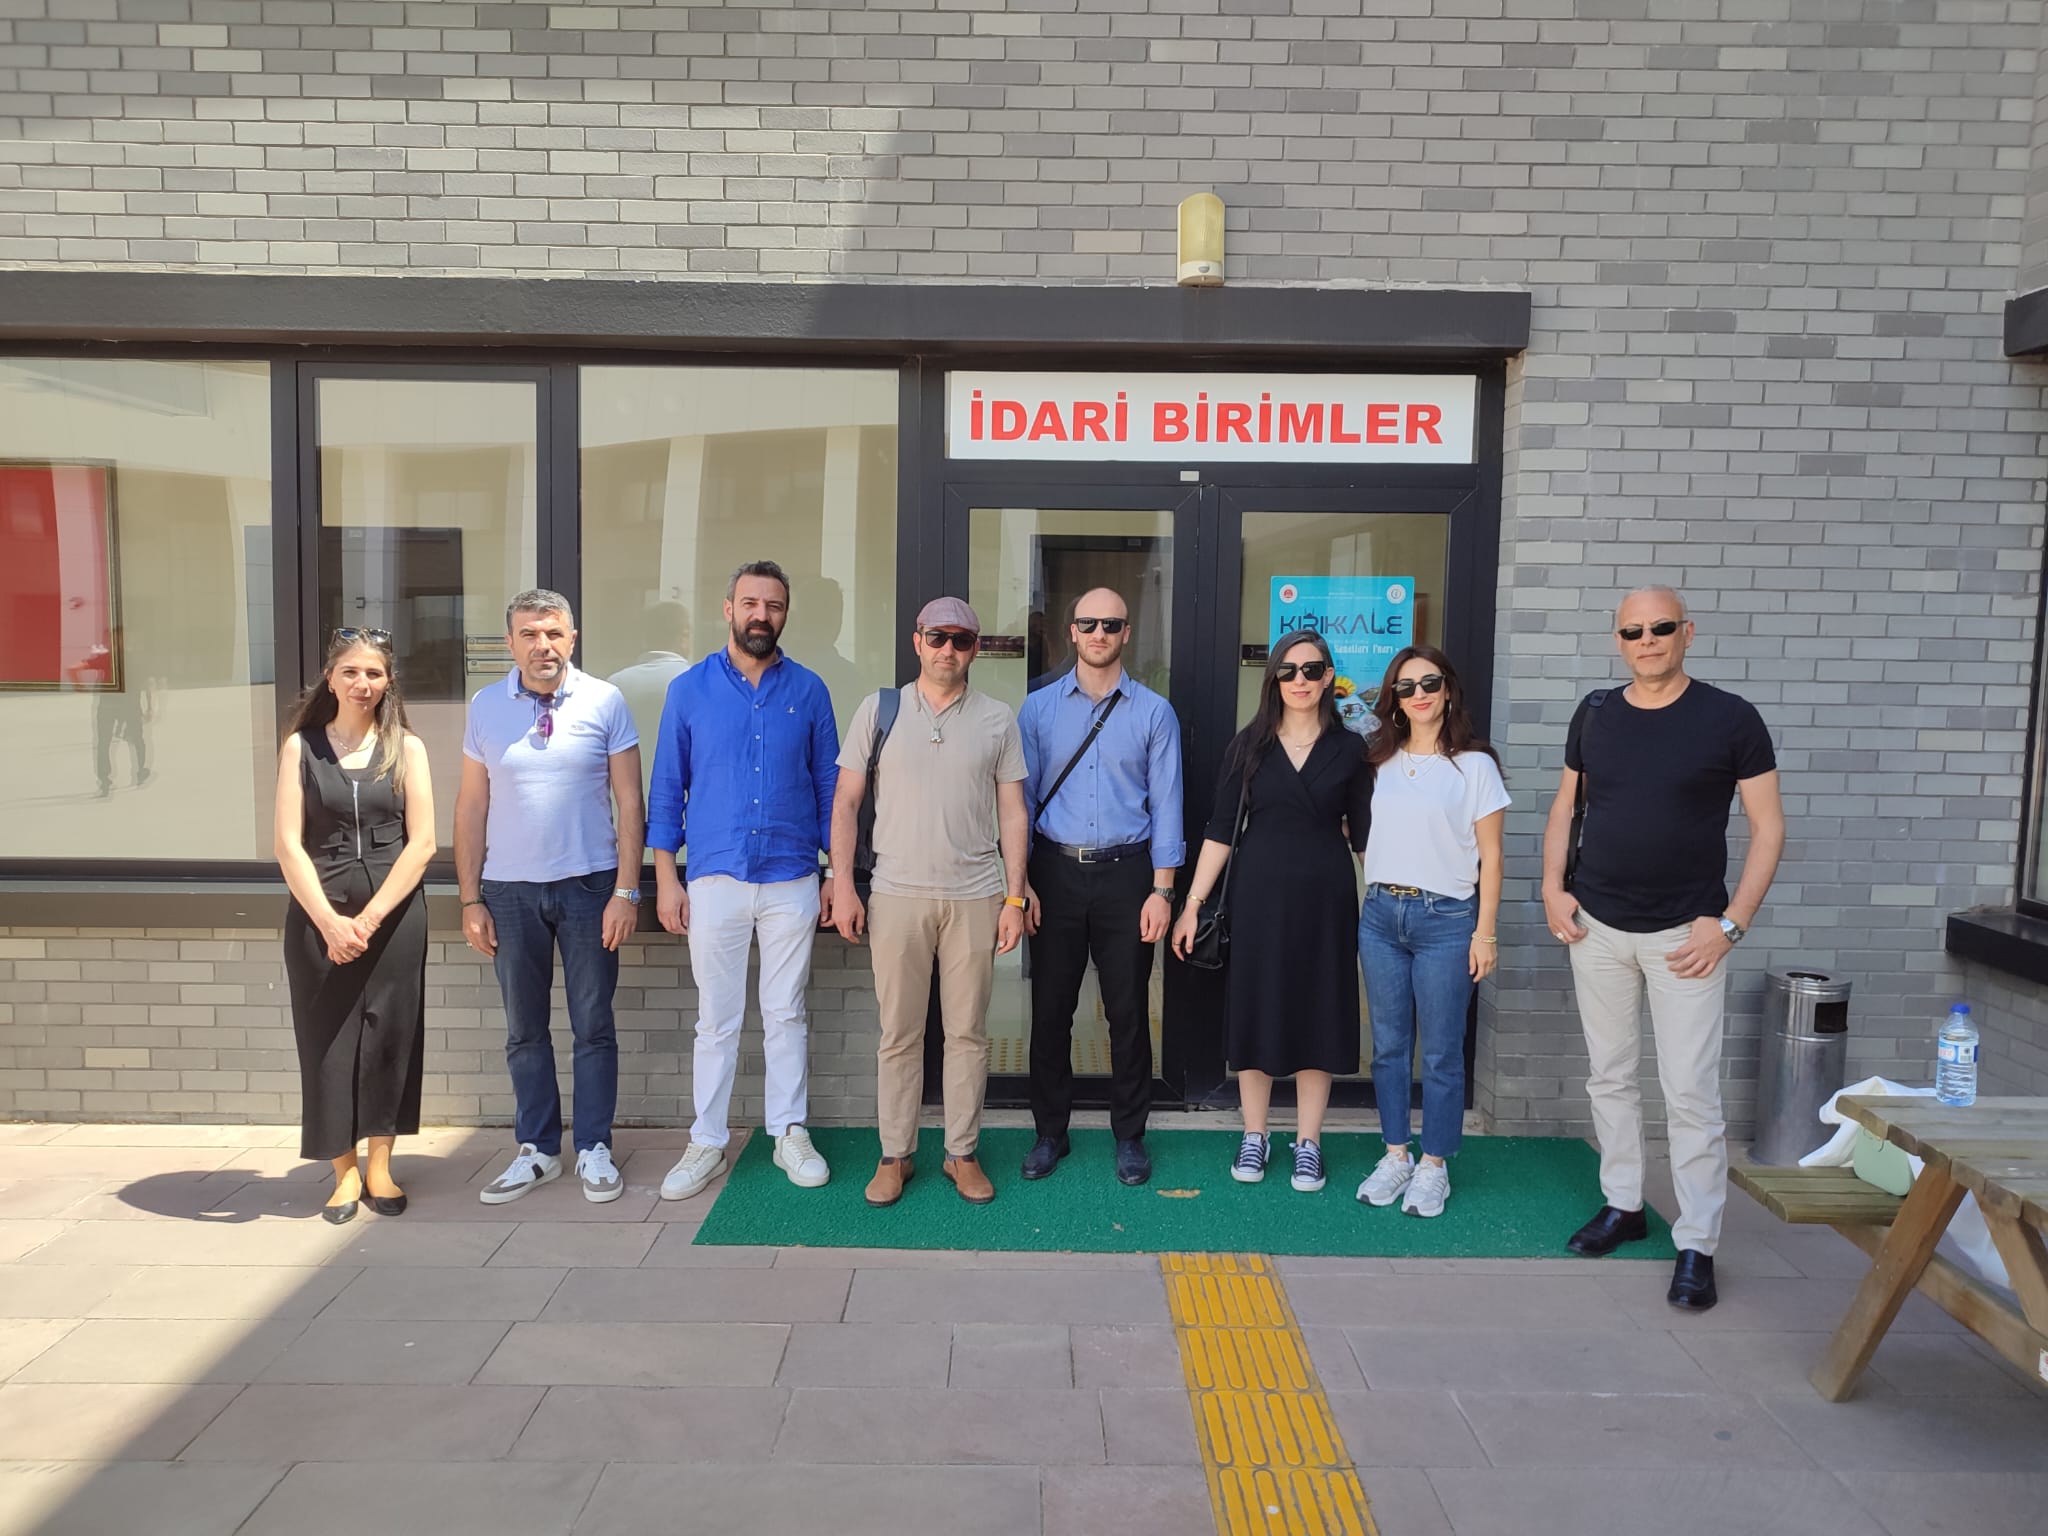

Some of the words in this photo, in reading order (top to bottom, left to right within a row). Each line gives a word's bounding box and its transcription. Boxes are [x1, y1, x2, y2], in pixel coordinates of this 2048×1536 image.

[969, 390, 1129, 443] İDARİ
[1153, 391, 1444, 445] BİRİMLER
[1280, 608, 1403, 635] KIRIKKALE
